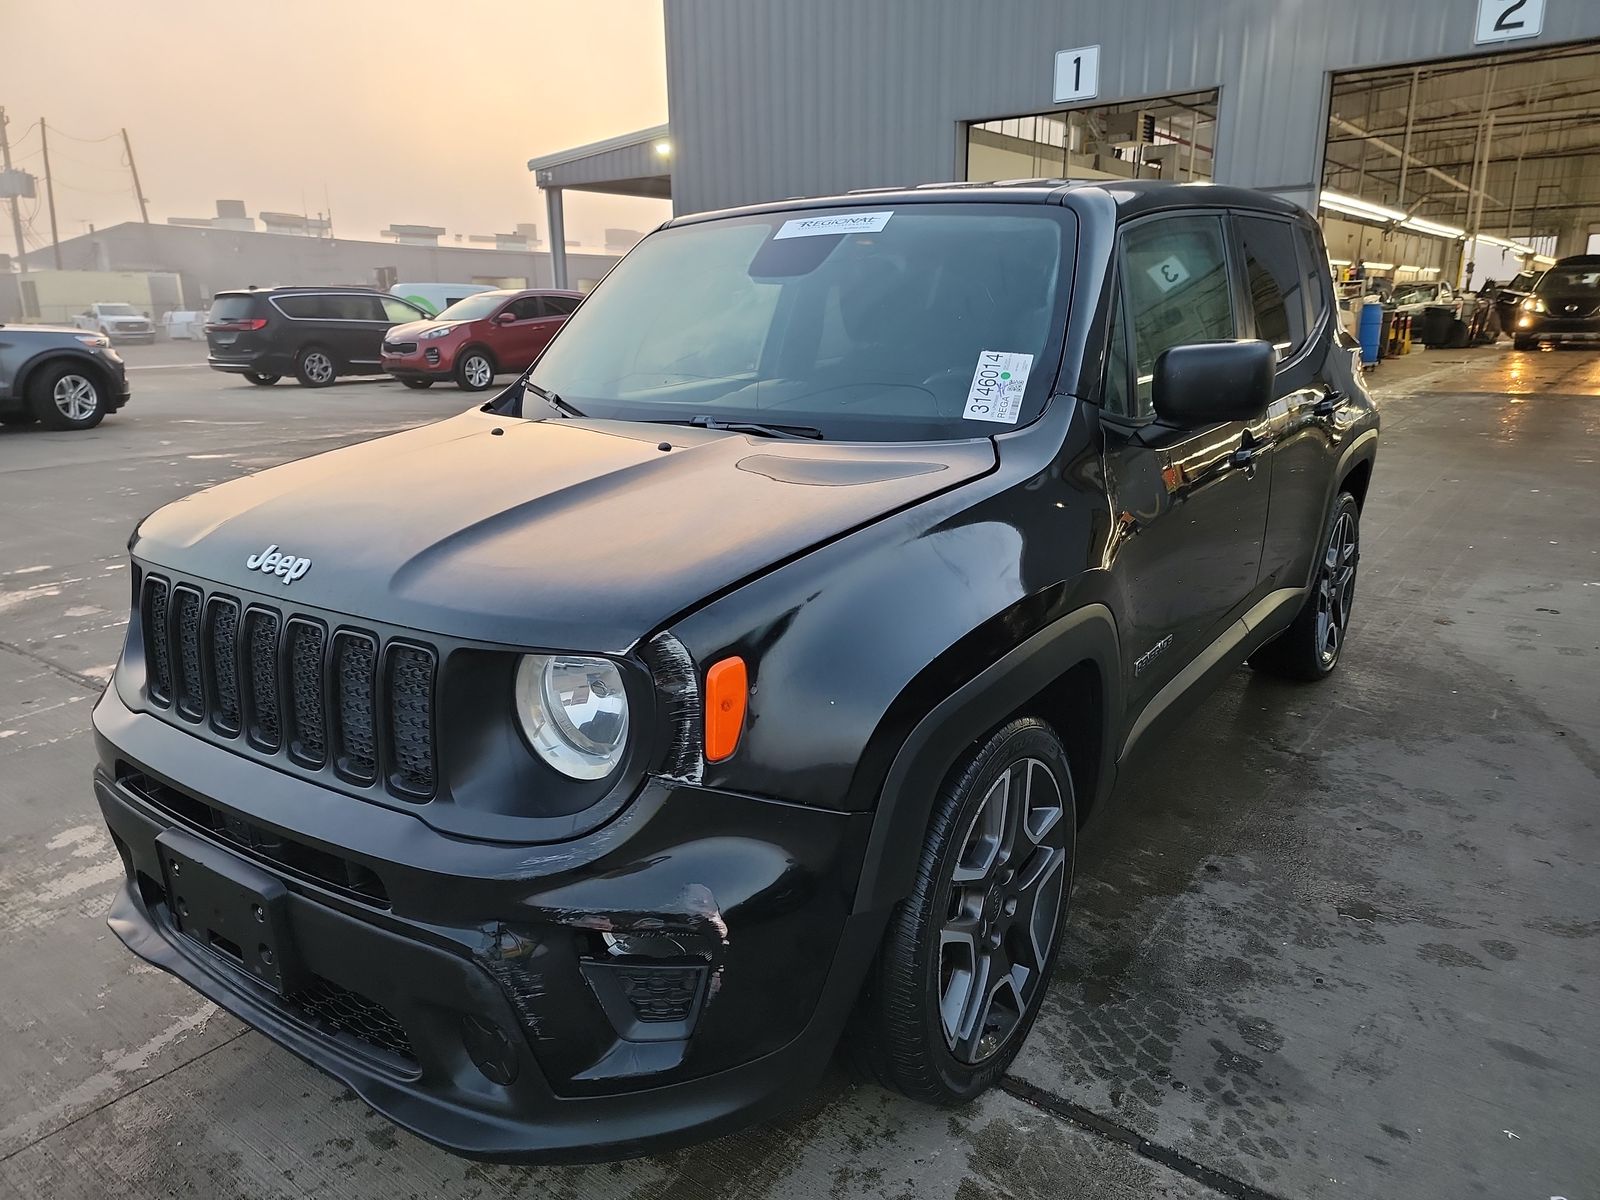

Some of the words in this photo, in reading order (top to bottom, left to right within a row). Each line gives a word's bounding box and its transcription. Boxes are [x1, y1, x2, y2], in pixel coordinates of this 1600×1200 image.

[1493, 0, 1527, 31] 2
[1073, 56, 1081, 91] 1
[970, 353, 1003, 414] 3146014
[997, 396, 1009, 418] REGA
[246, 544, 312, 585] Jeep
